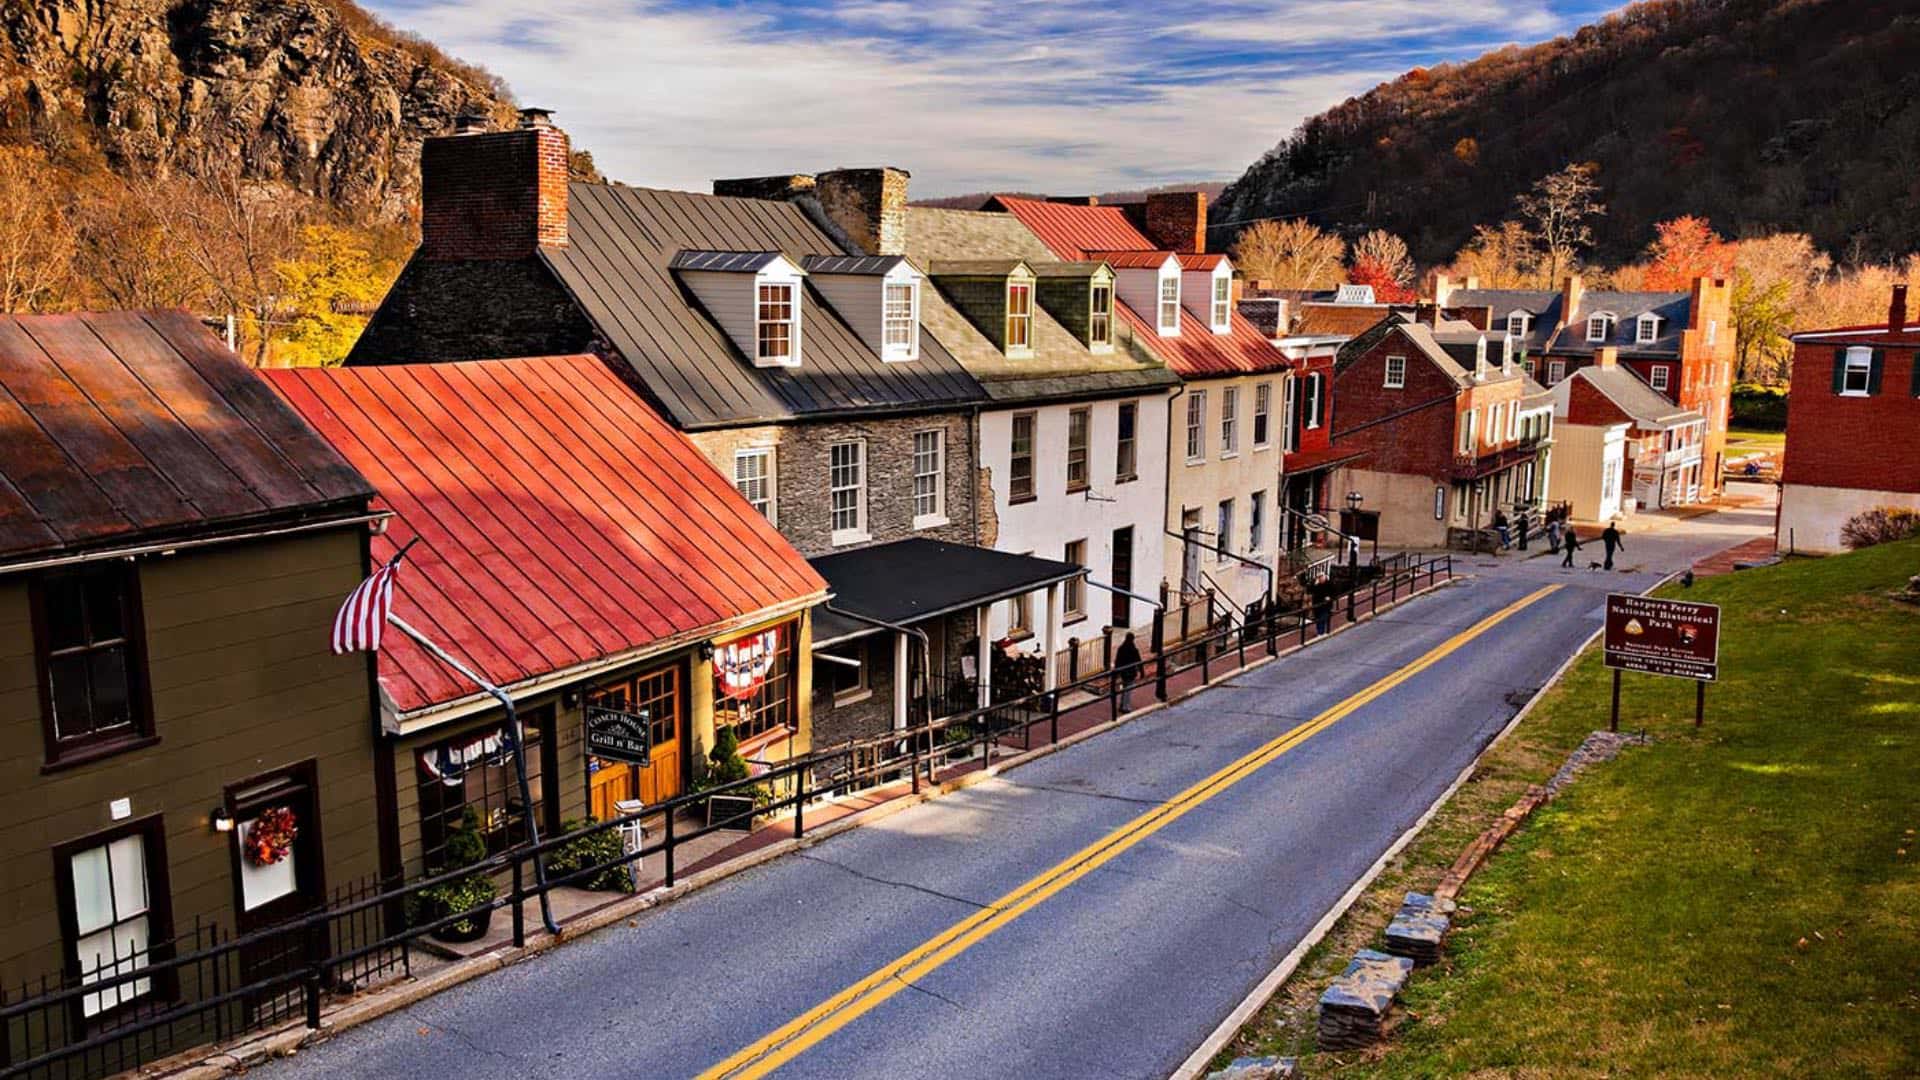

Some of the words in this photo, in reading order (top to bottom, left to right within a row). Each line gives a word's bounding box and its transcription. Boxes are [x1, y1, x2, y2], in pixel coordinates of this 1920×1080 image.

[1626, 598, 1667, 609] Harpers
[1670, 603, 1699, 614] Ferry
[1612, 606, 1655, 617] National
[1660, 611, 1712, 624] Historical
[1649, 619, 1672, 629] Park
[589, 713, 618, 728] COACH
[591, 733, 614, 745] Grill
[627, 740, 644, 752] Bar
